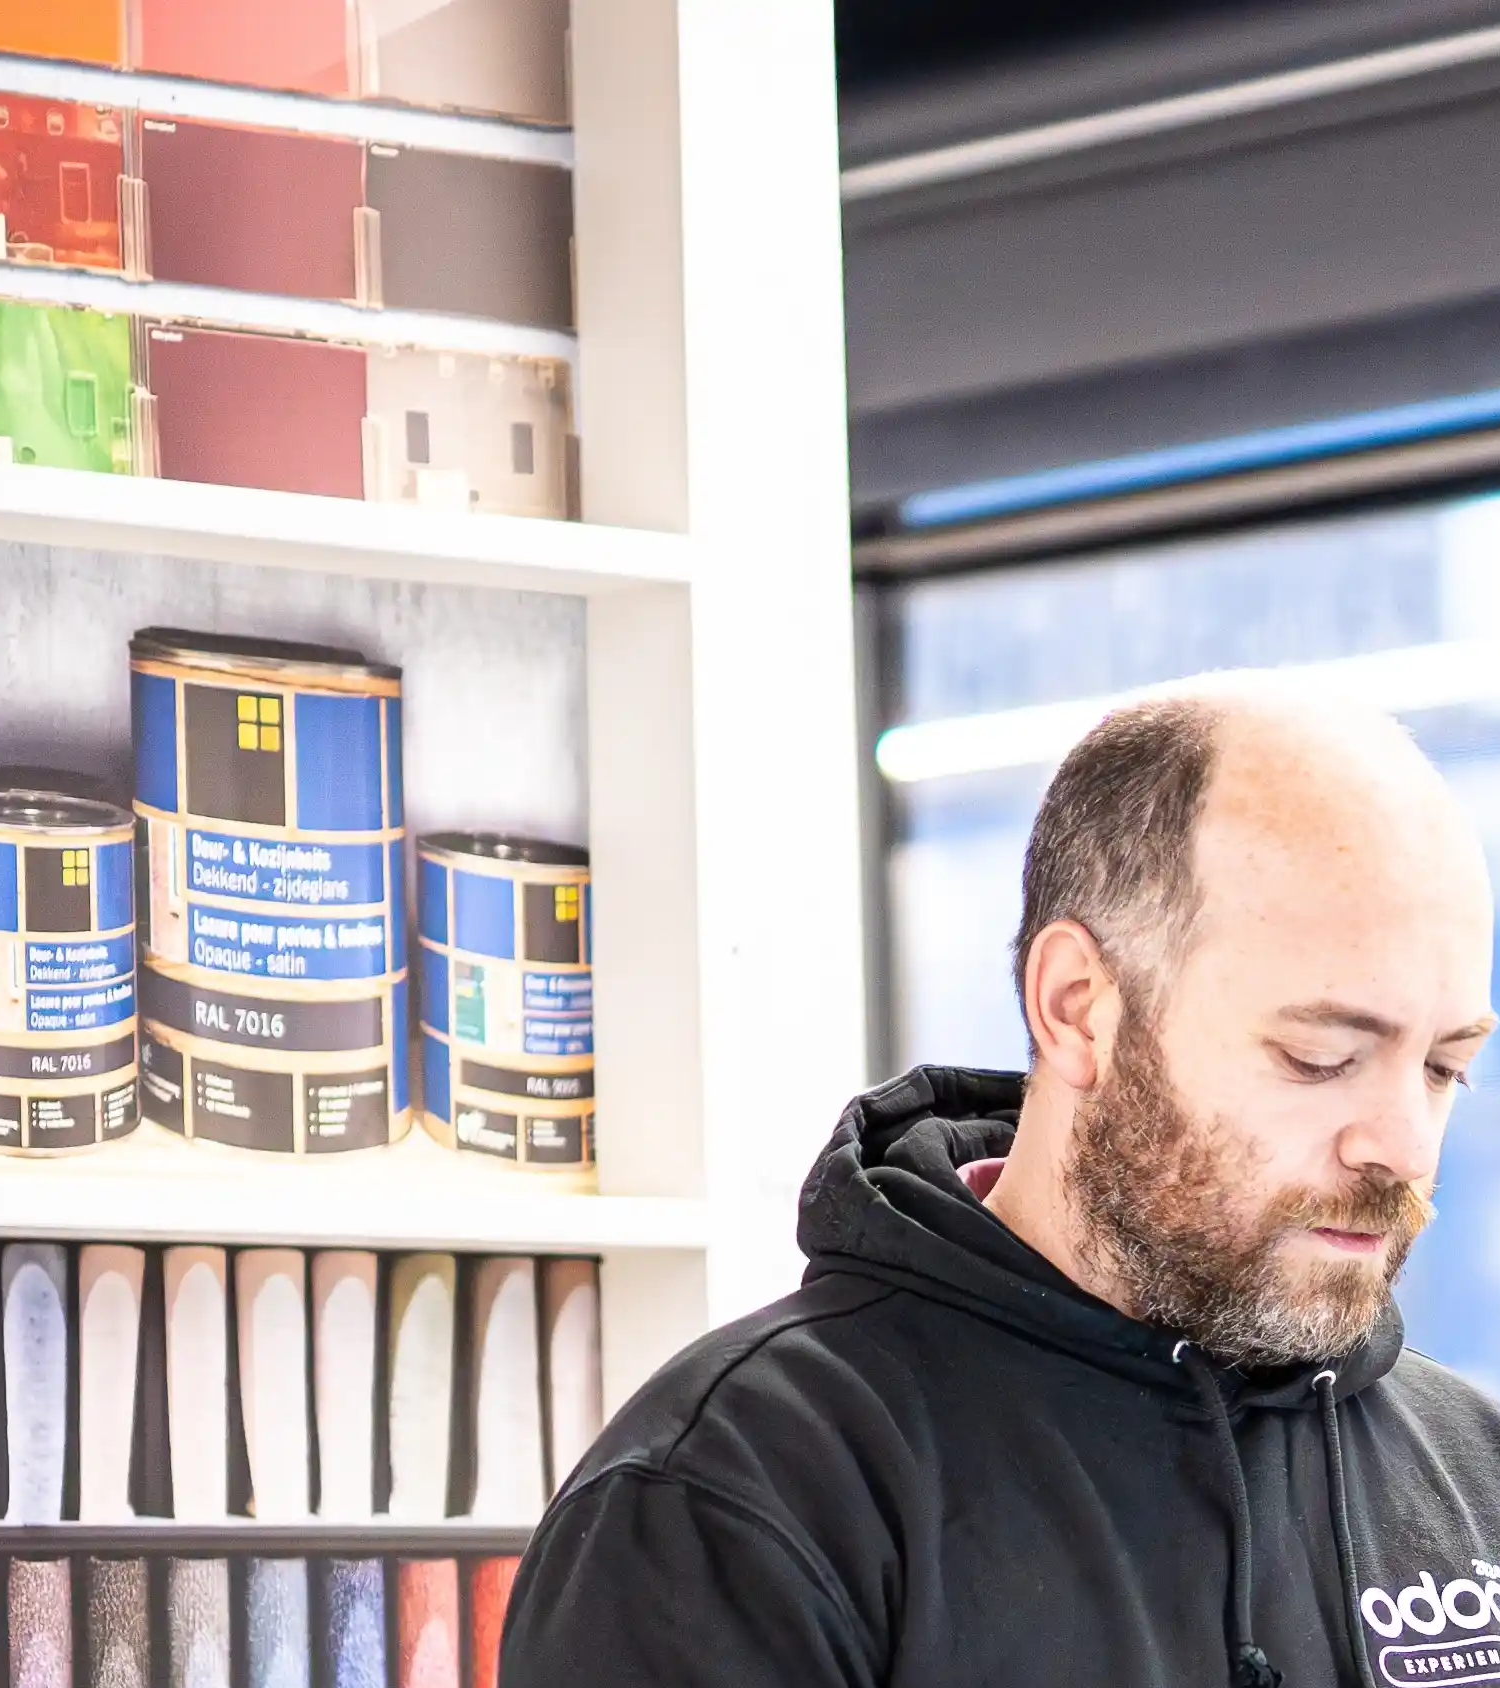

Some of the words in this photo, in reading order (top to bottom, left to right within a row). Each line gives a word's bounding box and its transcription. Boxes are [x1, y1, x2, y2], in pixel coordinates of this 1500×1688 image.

[194, 937, 252, 972] Opaque
[194, 1000, 232, 1032] RAL
[234, 1007, 287, 1040] 7016
[31, 1055, 58, 1074] RAL
[60, 1052, 93, 1074] 7016
